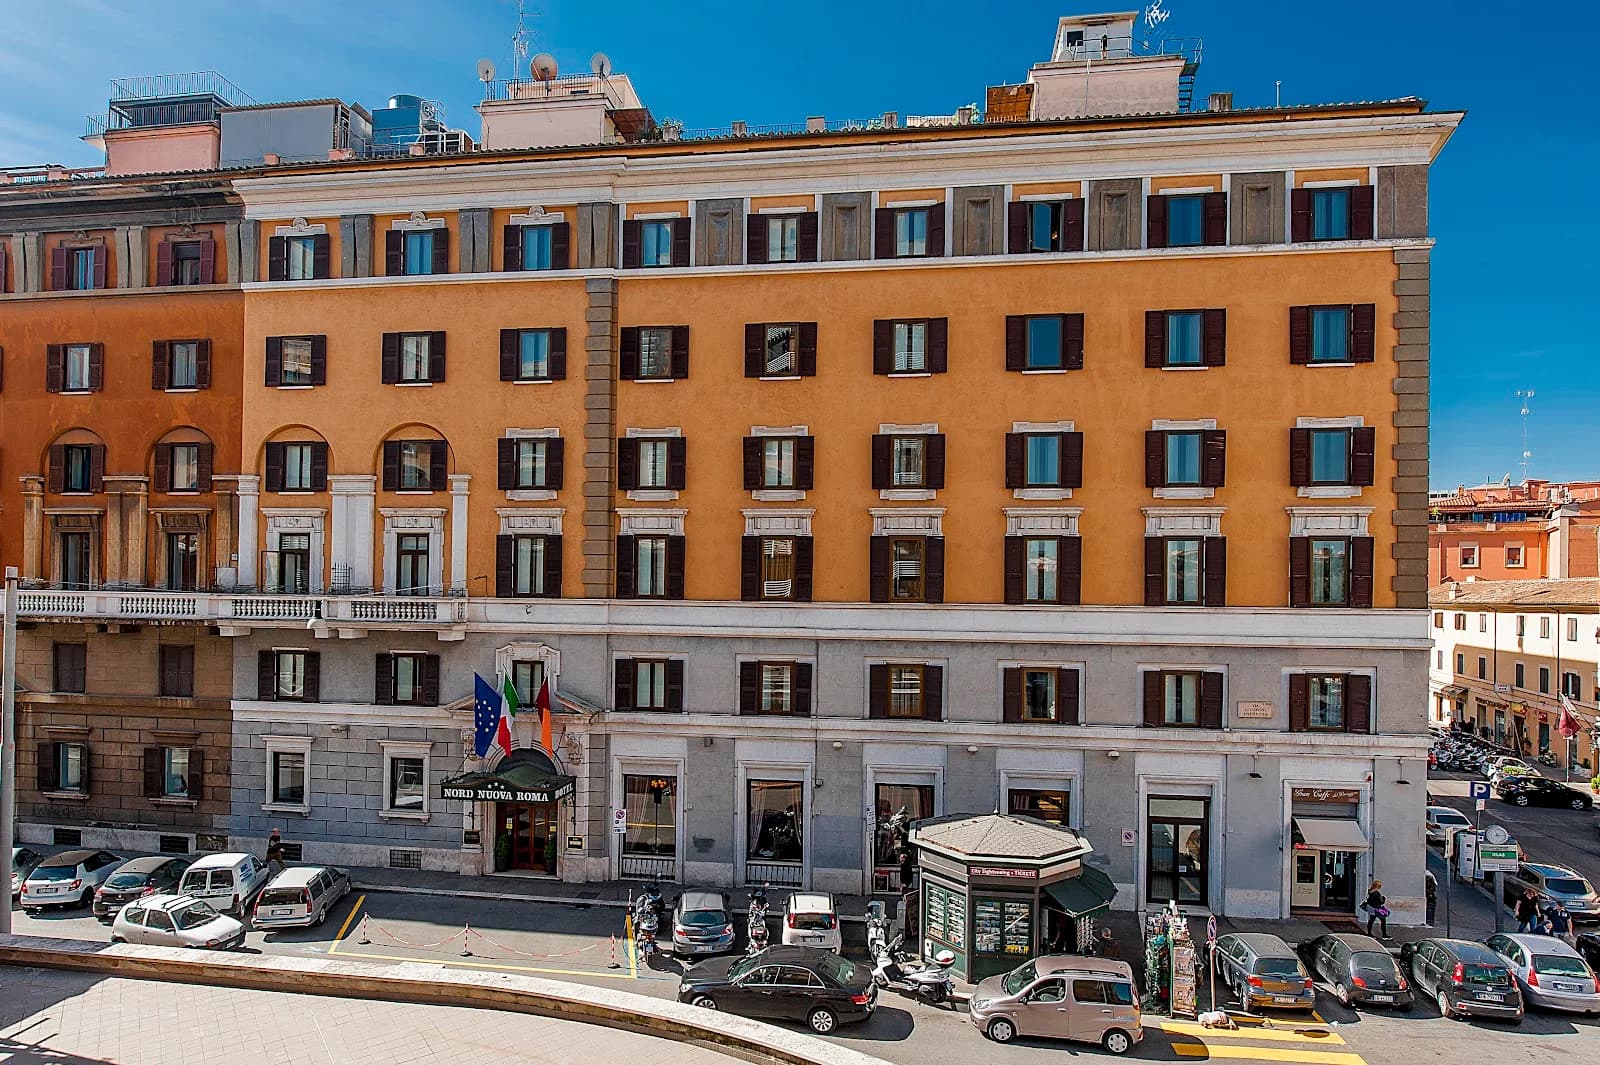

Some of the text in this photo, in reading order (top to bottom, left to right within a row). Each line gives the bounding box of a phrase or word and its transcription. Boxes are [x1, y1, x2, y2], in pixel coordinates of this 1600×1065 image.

[443, 788, 549, 802] NORD NUOVA ROMA
[554, 783, 574, 799] HOTEL
[1474, 784, 1487, 797] P
